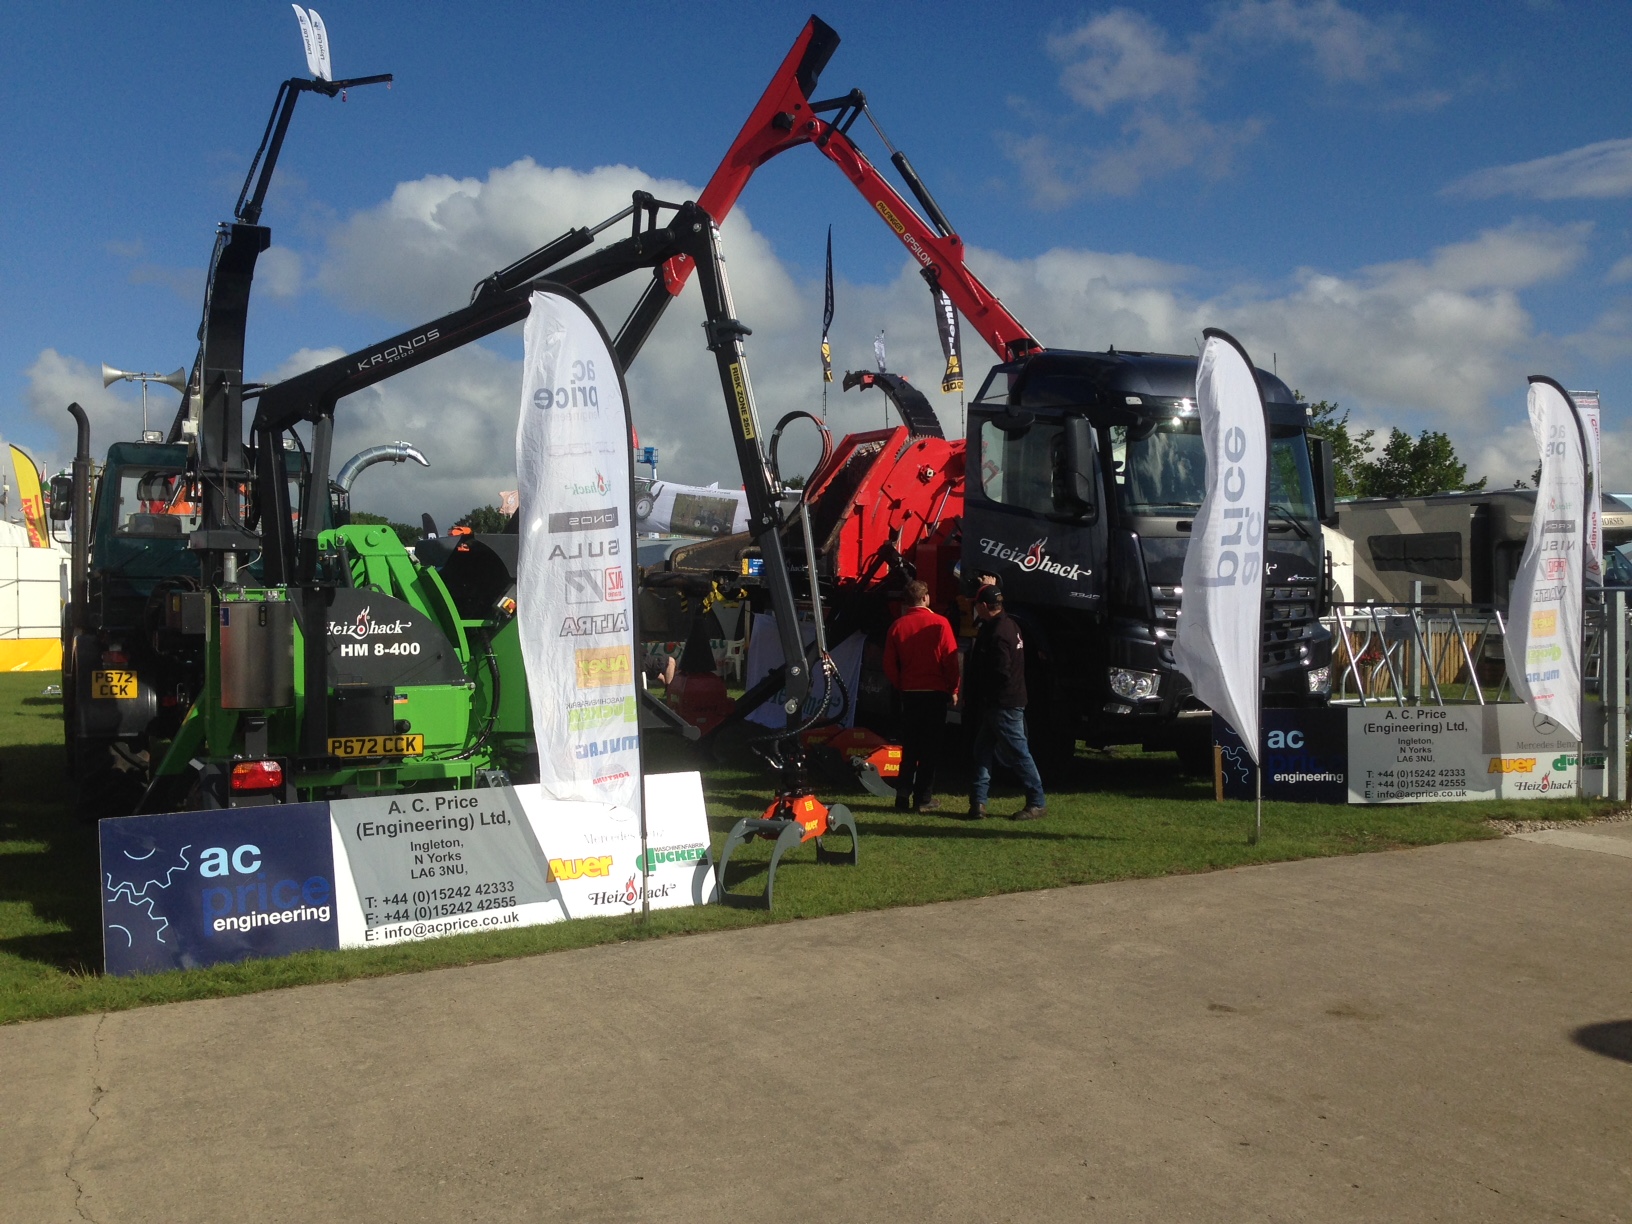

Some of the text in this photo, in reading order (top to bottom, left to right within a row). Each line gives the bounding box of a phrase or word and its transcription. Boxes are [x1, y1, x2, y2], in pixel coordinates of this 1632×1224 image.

[877, 202, 904, 232] PALFINGER
[903, 233, 932, 265] EPSILON
[357, 329, 440, 370] KRONOS
[387, 349, 415, 363] 4000
[731, 366, 751, 436] RISK ZONE 25m
[341, 642, 421, 657] HM 8-400
[95, 672, 133, 683] P672
[100, 684, 128, 696] CCK
[1385, 709, 1447, 720] A. C. Price
[1363, 721, 1468, 735] (Engineering) Ltd,
[331, 736, 416, 755] P672 CCK
[1267, 730, 1305, 749] ac
[1397, 738, 1435, 747] Ingleton,
[1516, 740, 1577, 750] Mercedes Benz
[1409, 746, 1432, 754] Yorks
[1487, 757, 1537, 774] Auer
[1273, 771, 1344, 784] engineering
[1366, 768, 1466, 779] T: +44 (0)15242 42333
[1377, 780, 1395, 788] +44
[1397, 780, 1437, 789] (0)15242
[1439, 778, 1466, 787] 42555
[1377, 789, 1467, 800] info@acprice.co.uk
[388, 796, 479, 815] A. C. Price
[356, 810, 511, 841] (Engineering) Ltd,
[410, 839, 464, 853] Ingleton,
[654, 842, 705, 852] MASCHINENFABRIK
[199, 844, 262, 878] ac
[414, 852, 462, 865] N Yorks
[410, 864, 468, 879] LA6 3NU,
[546, 855, 613, 883] Auer
[365, 880, 515, 909] T: +44 (0)15242 42333
[202, 872, 331, 937] price
[365, 895, 517, 925] F: +44 (0)15242 42555
[213, 905, 331, 932] engineering
[365, 911, 520, 942] E: info@acprice.co.uk
